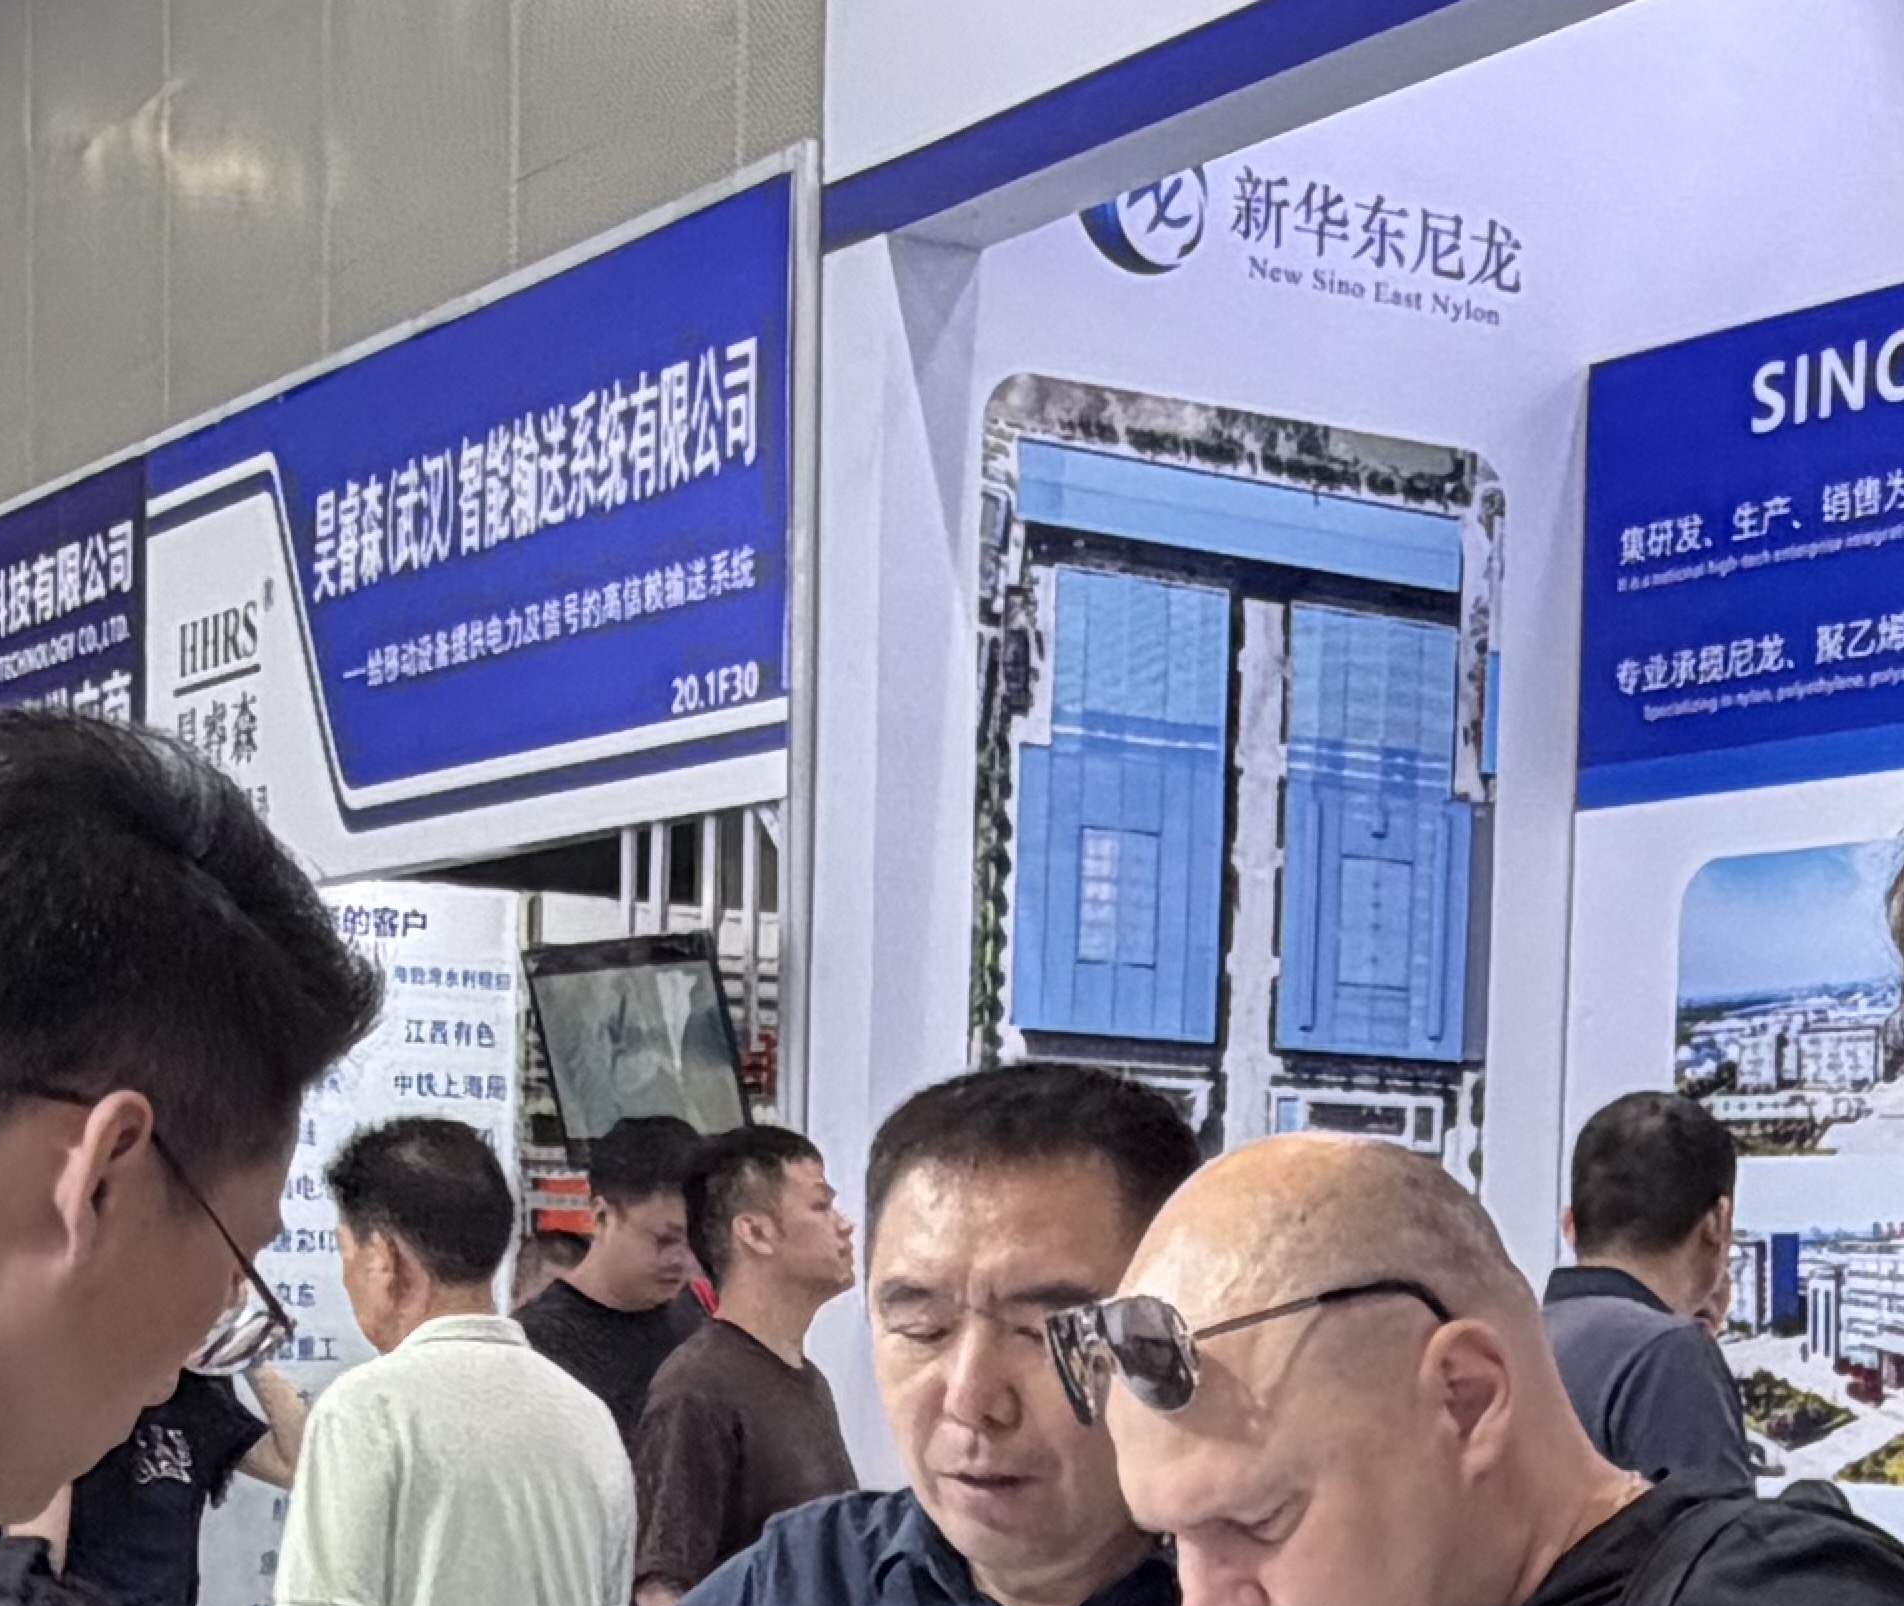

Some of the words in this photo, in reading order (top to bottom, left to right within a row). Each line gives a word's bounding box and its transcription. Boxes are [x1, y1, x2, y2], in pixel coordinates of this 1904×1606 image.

[1230, 165, 1522, 294] 新华东尼龙
[1248, 254, 1302, 287] New
[1312, 267, 1364, 299] Sino
[1374, 279, 1421, 310] East
[1430, 290, 1499, 329] Nylon
[180, 600, 257, 679] HHRS
[671, 661, 759, 714] 20.1F30
[405, 1020, 495, 1048] 江西有色
